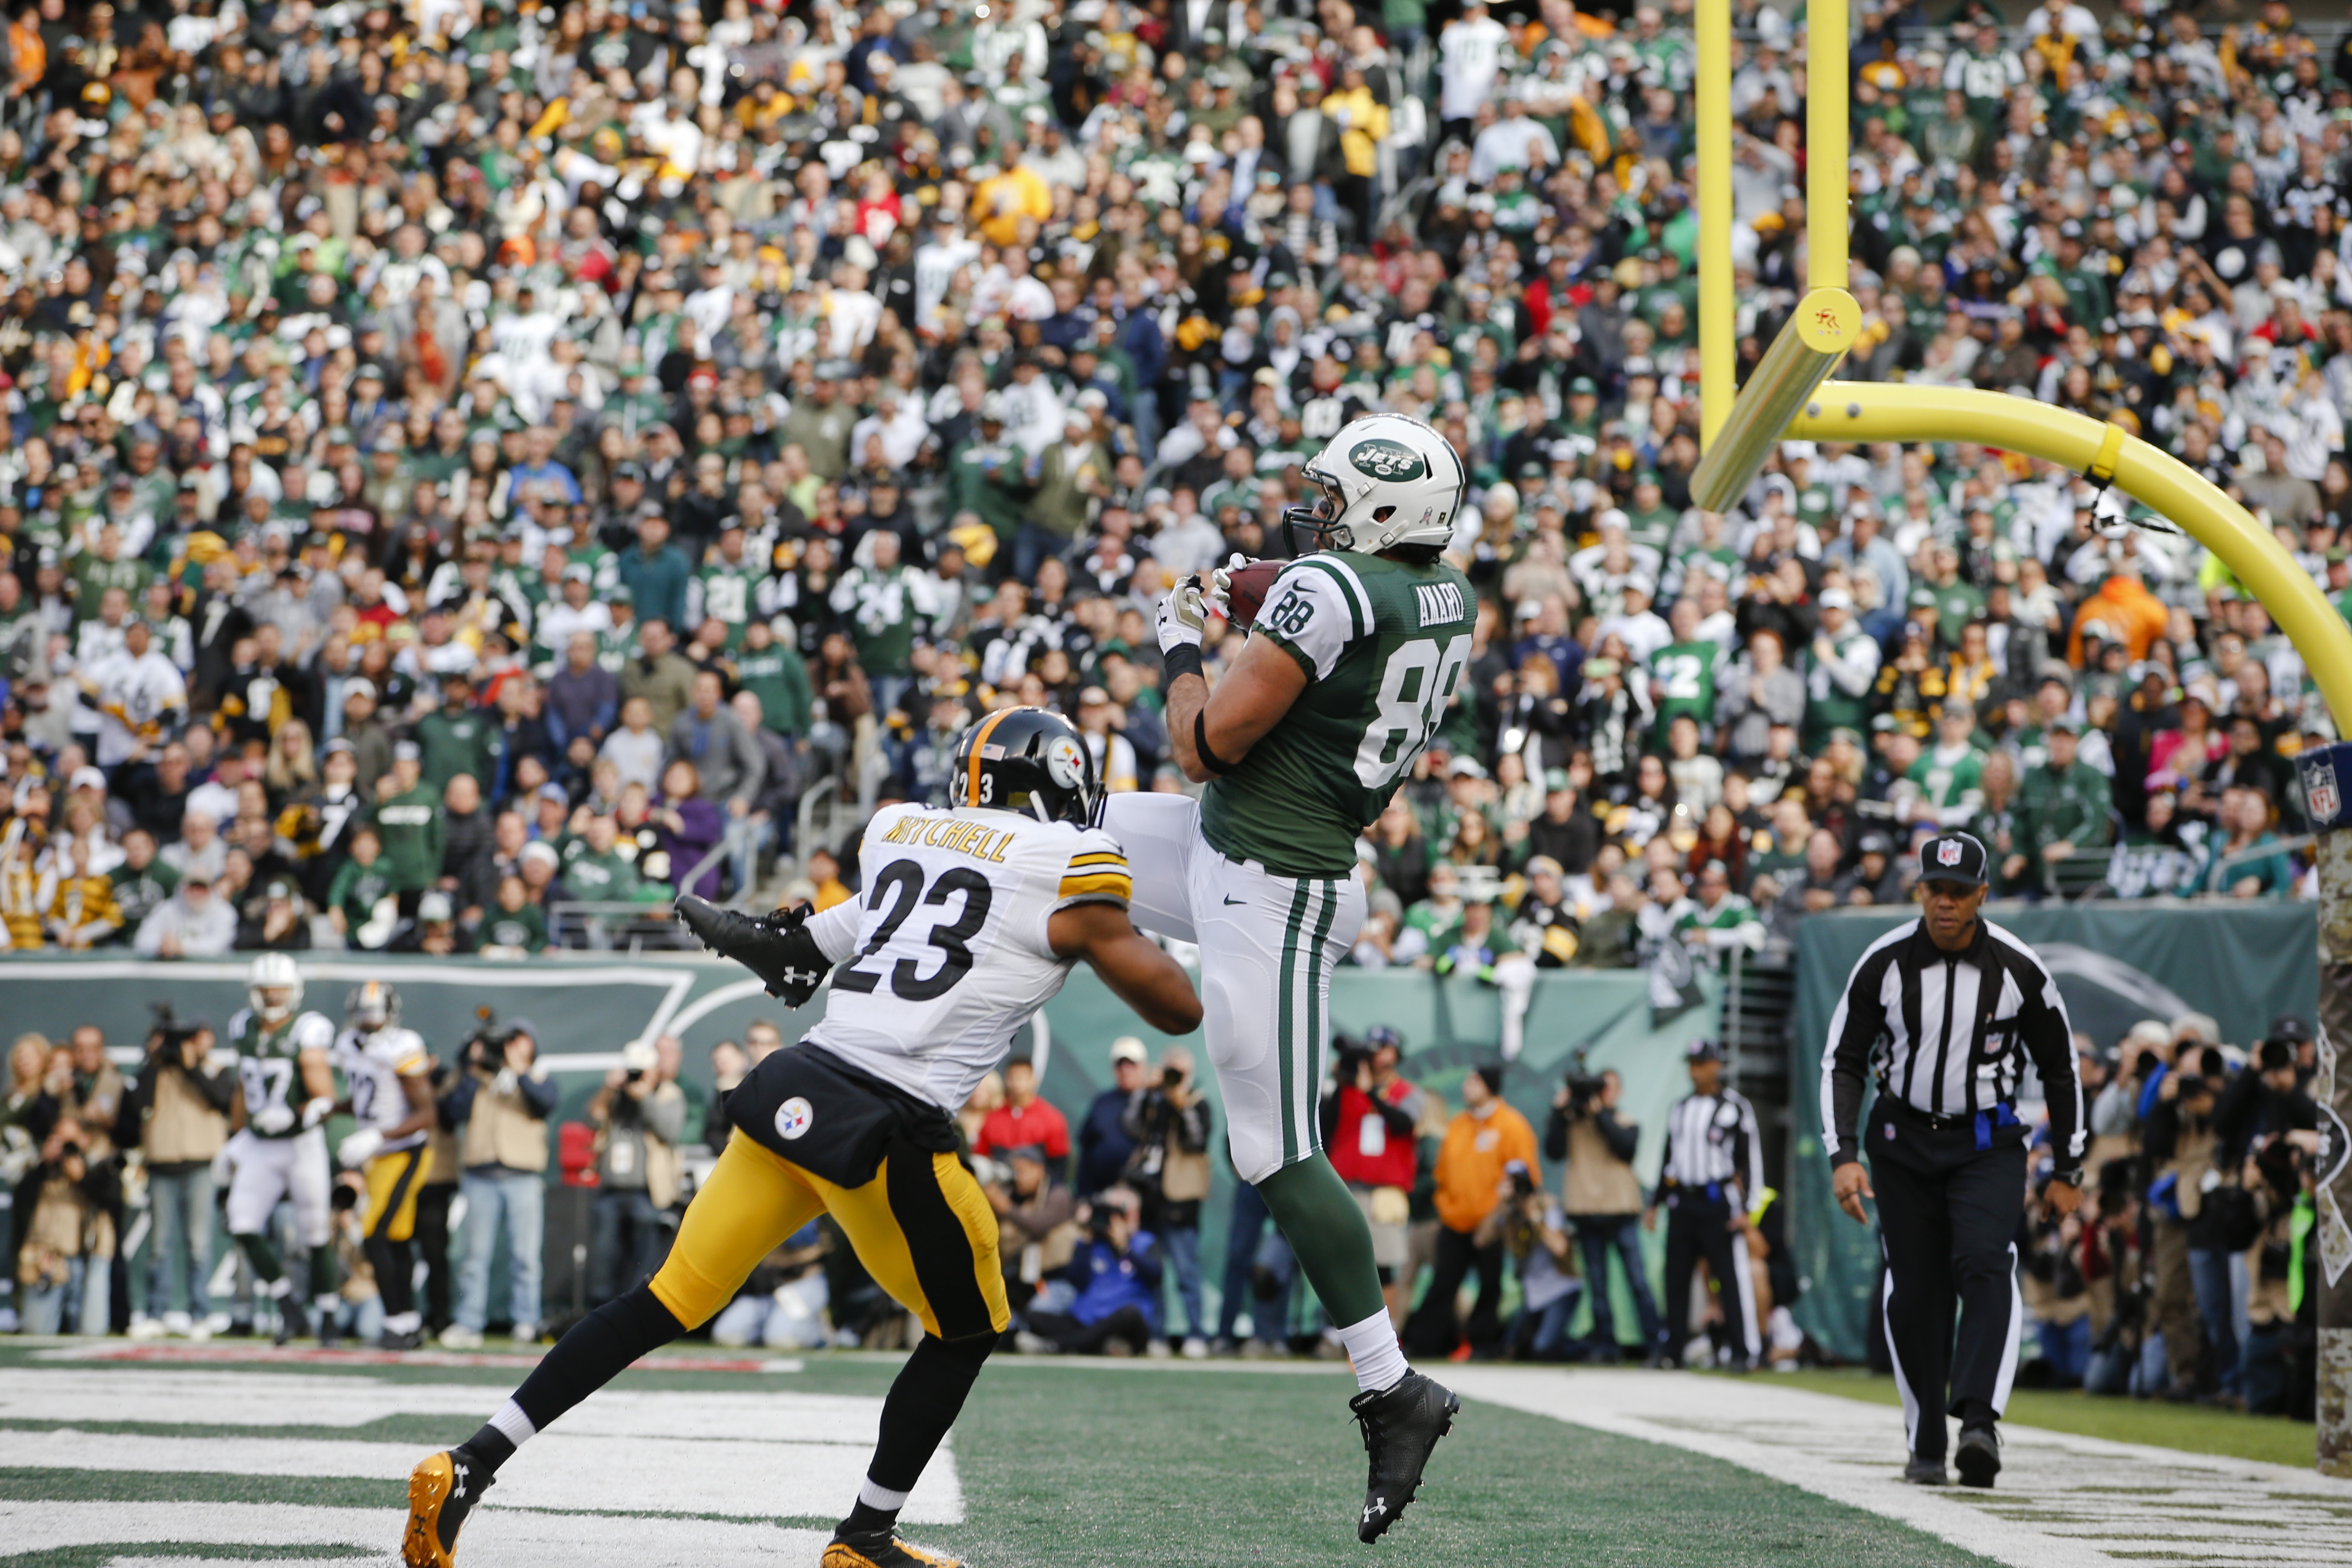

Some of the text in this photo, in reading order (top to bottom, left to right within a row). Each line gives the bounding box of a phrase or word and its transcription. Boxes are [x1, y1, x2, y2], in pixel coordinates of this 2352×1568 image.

[1357, 448, 1414, 470] JETS
[1271, 591, 1314, 634] 88
[1416, 582, 1464, 627] AMARO
[1352, 633, 1473, 789] 88
[881, 815, 1016, 864] MITCHELL
[830, 859, 992, 1001] 23
